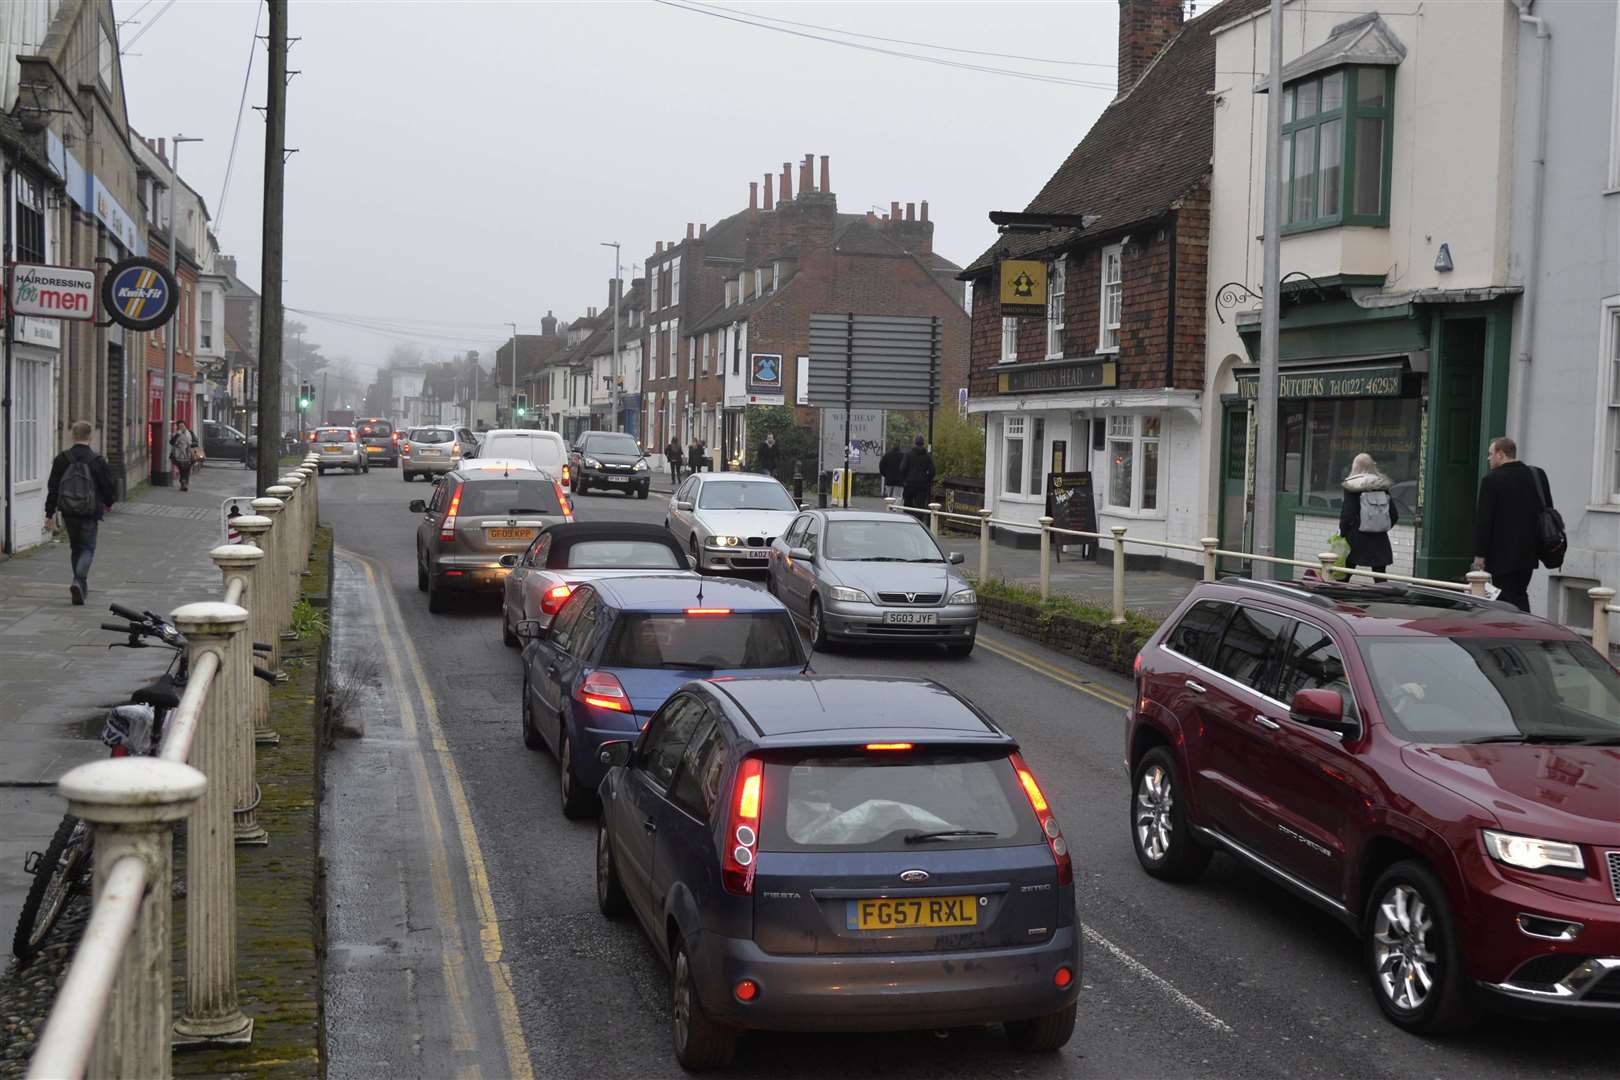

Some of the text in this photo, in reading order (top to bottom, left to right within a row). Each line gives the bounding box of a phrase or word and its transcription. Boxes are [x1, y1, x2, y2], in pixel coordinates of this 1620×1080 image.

[16, 274, 92, 289] HAIRDRESSING
[16, 282, 88, 311] for men
[118, 287, 162, 299] Kwik-Fit
[1060, 367, 1083, 386] HEAD
[1280, 376, 1324, 397] BUTCHERS
[916, 614, 933, 623] JYF
[862, 900, 973, 925] FG57 RXL
